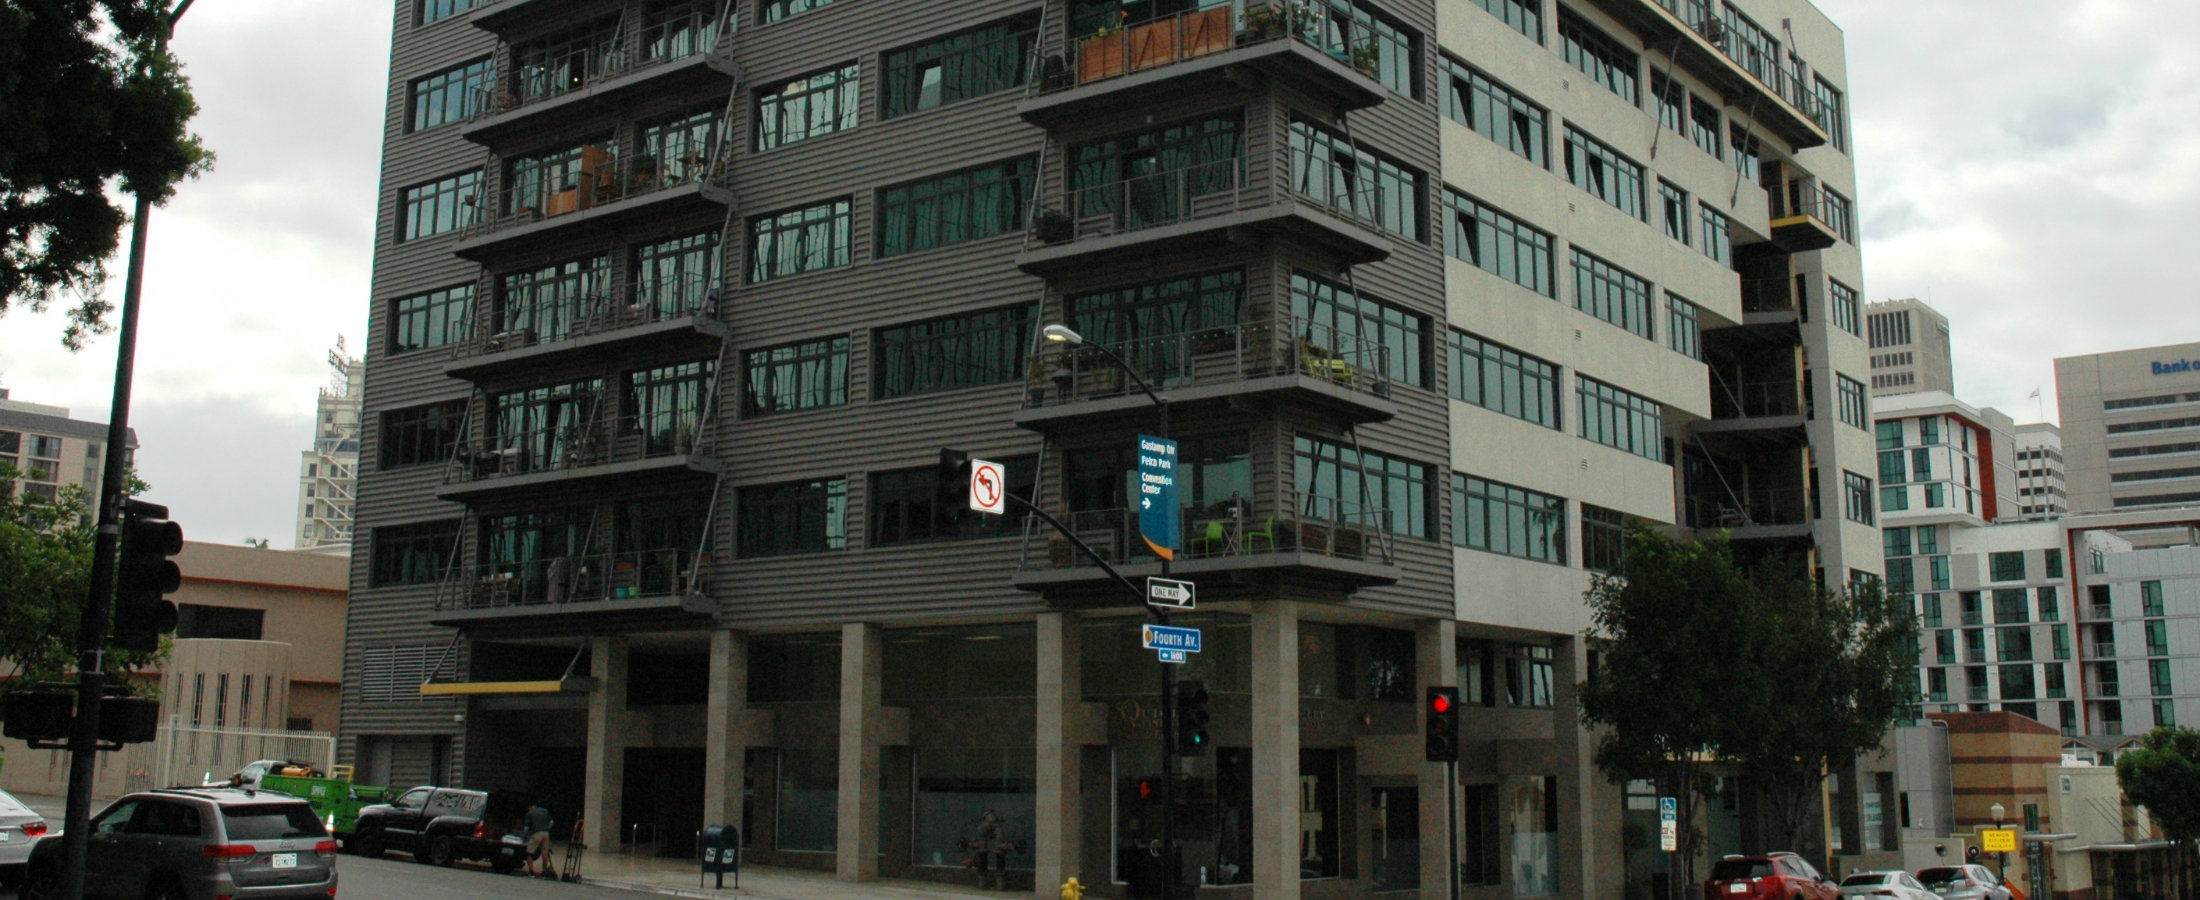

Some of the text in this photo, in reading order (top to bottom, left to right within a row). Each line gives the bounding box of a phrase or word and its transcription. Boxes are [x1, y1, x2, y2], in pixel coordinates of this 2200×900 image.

[2151, 358, 2191, 375] Bank
[1142, 440, 1165, 455] Gaslamp
[1142, 456, 1171, 469] Petco Park
[1141, 472, 1172, 486] Convention
[1142, 482, 1161, 494] Center
[1154, 588, 1179, 599] ONE WAY
[1154, 631, 1182, 646] FOURTH
